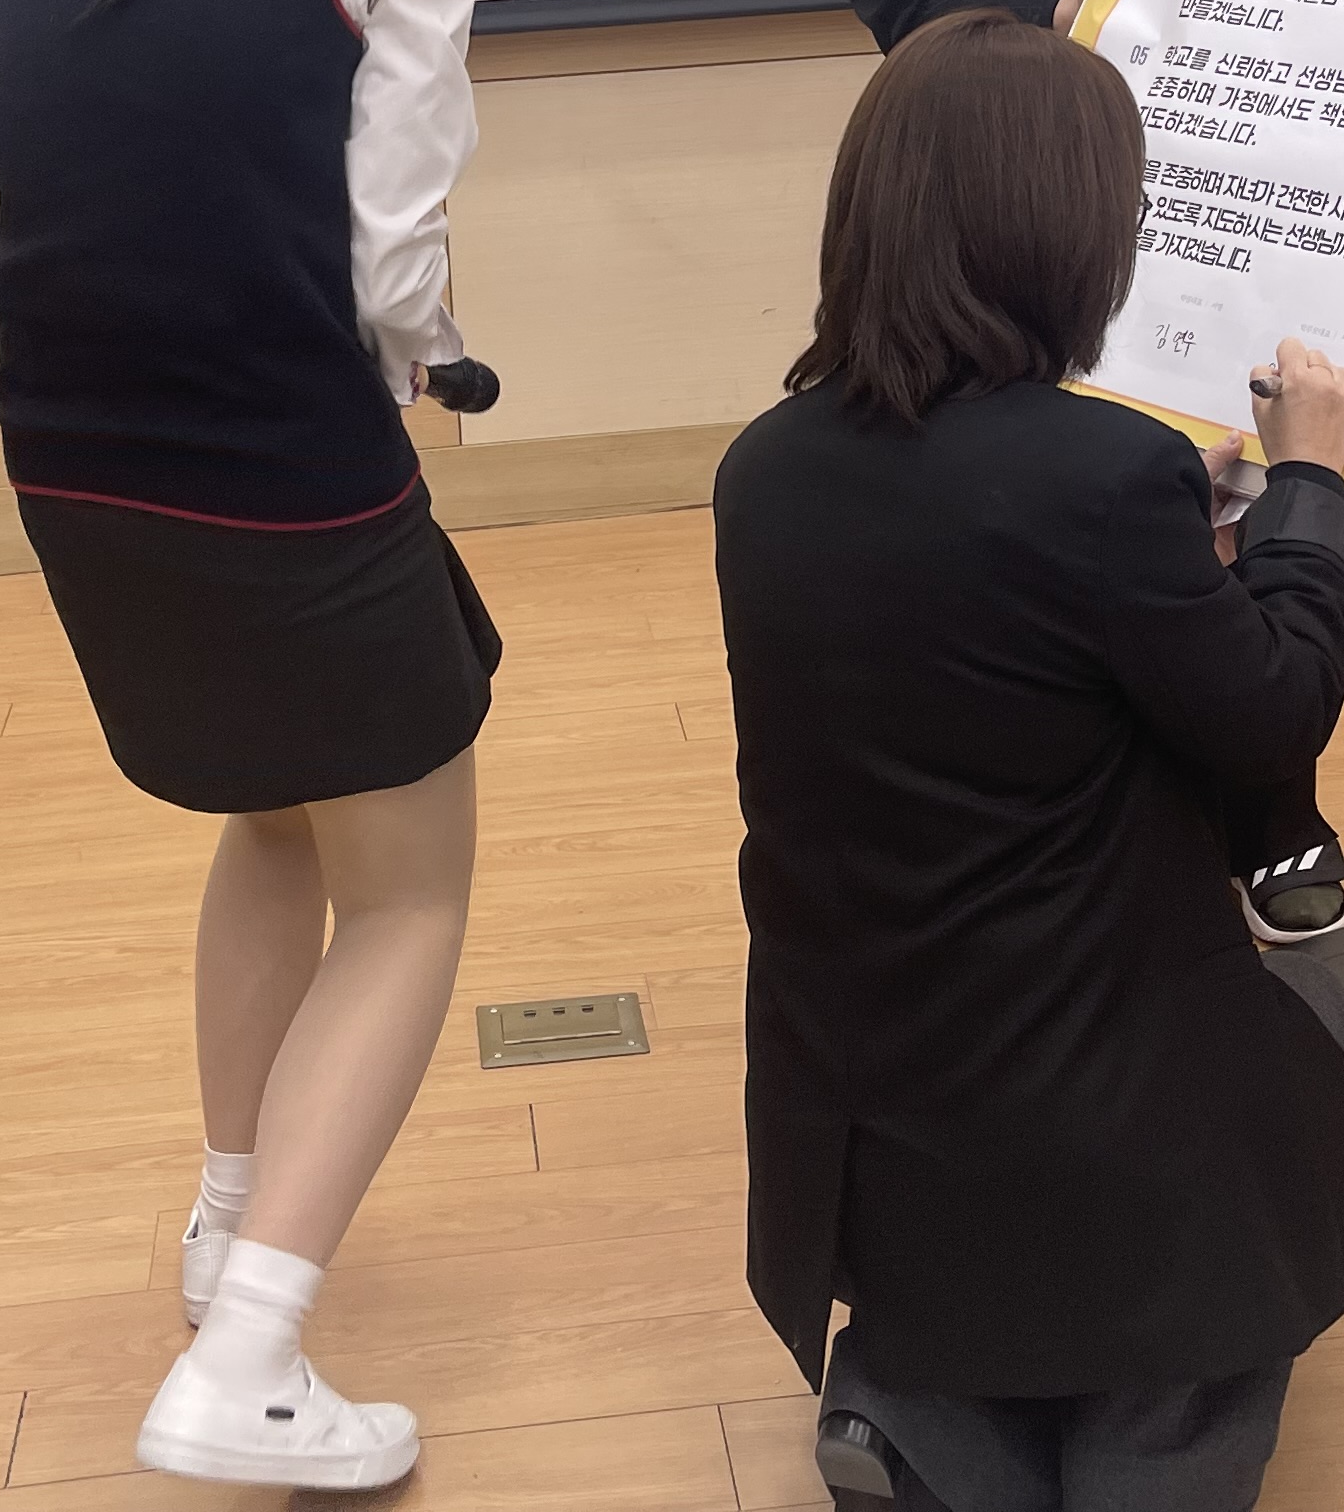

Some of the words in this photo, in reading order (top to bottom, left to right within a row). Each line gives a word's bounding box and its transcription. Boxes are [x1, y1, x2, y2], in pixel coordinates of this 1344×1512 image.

[1130, 45, 1150, 65] 05
[1162, 45, 1212, 71] 학교를
[1214, 52, 1293, 85] 신뢰하고
[1147, 76, 1217, 105] 존중하며
[1219, 85, 1315, 122] 가정에서도
[1160, 163, 1225, 195] 존중하며
[1223, 174, 1275, 206] 자녀가
[1275, 184, 1329, 216] 건전한
[1152, 196, 1203, 227] 있도록
[1201, 206, 1283, 244] 지도하시는
[1155, 231, 1252, 273] 가지겠습니다.
